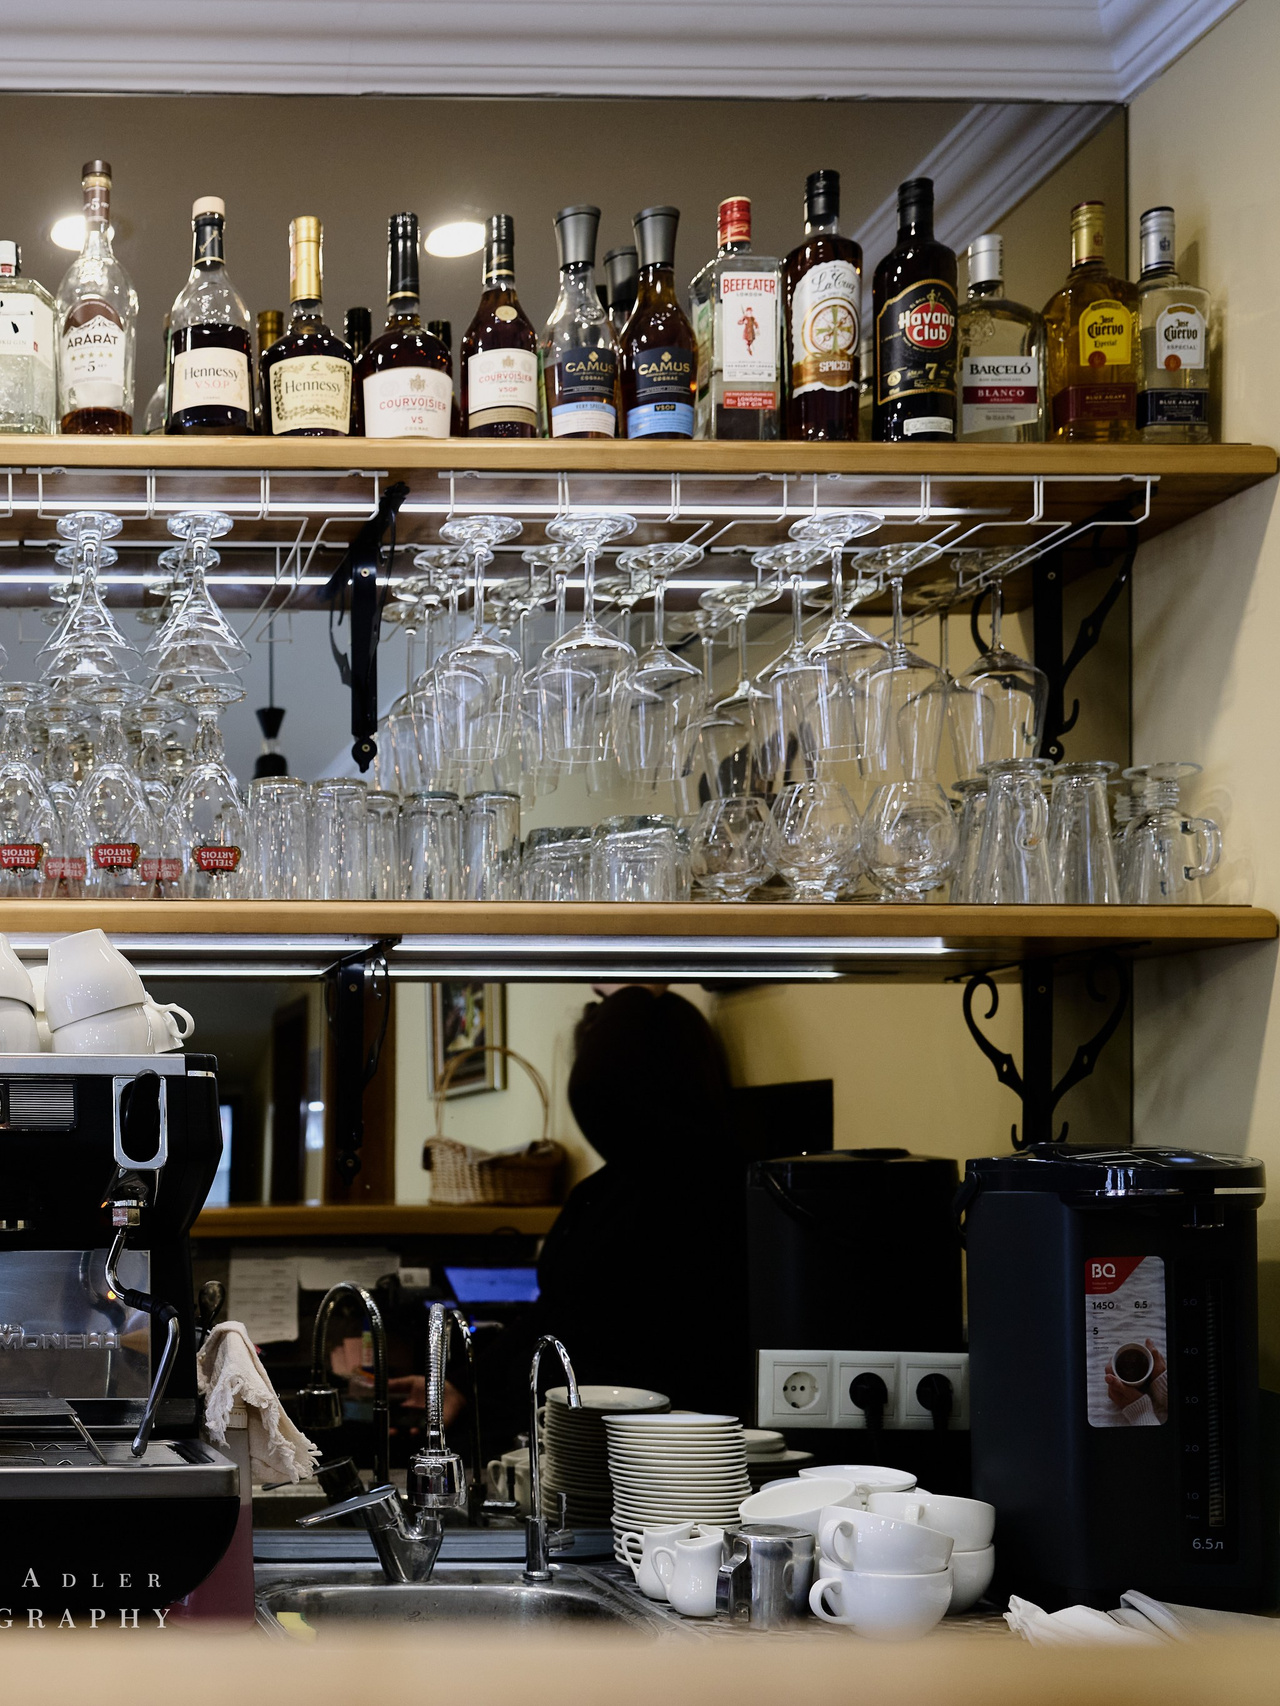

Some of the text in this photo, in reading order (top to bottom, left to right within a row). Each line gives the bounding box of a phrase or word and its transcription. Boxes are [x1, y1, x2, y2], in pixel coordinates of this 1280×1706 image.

[723, 278, 776, 295] BEEFEATER
[898, 310, 955, 330] Havana
[912, 325, 948, 342] Club
[1087, 321, 1124, 339] Cuervo
[1163, 325, 1198, 342] Cuervo
[67, 333, 119, 350] ARARAT
[87, 360, 96, 373] 5
[564, 361, 615, 373] CAMUS
[637, 362, 691, 375] CAMUS
[819, 361, 851, 372] SPICED
[970, 362, 1031, 376] BARCELÓ
[184, 366, 240, 382] Hennessy
[479, 373, 533, 384] COURVOISIER
[284, 379, 342, 395] Hennessy
[977, 389, 1025, 397] BLANCO
[379, 397, 447, 411] COURVOISIER
[411, 416, 424, 424] VS
[1, 848, 37, 857] ARTOIS
[98, 848, 133, 856] ARTOIS
[200, 851, 235, 859] ARTOIS
[2, 856, 36, 864] STELLA
[98, 856, 132, 864] STELLA
[201, 859, 235, 867] STELLA
[1091, 1263, 1116, 1279] BQ
[1092, 1301, 1115, 1310] 1450
[1134, 1300, 1148, 1309] 6.5
[1092, 1326, 1099, 1335] 5
